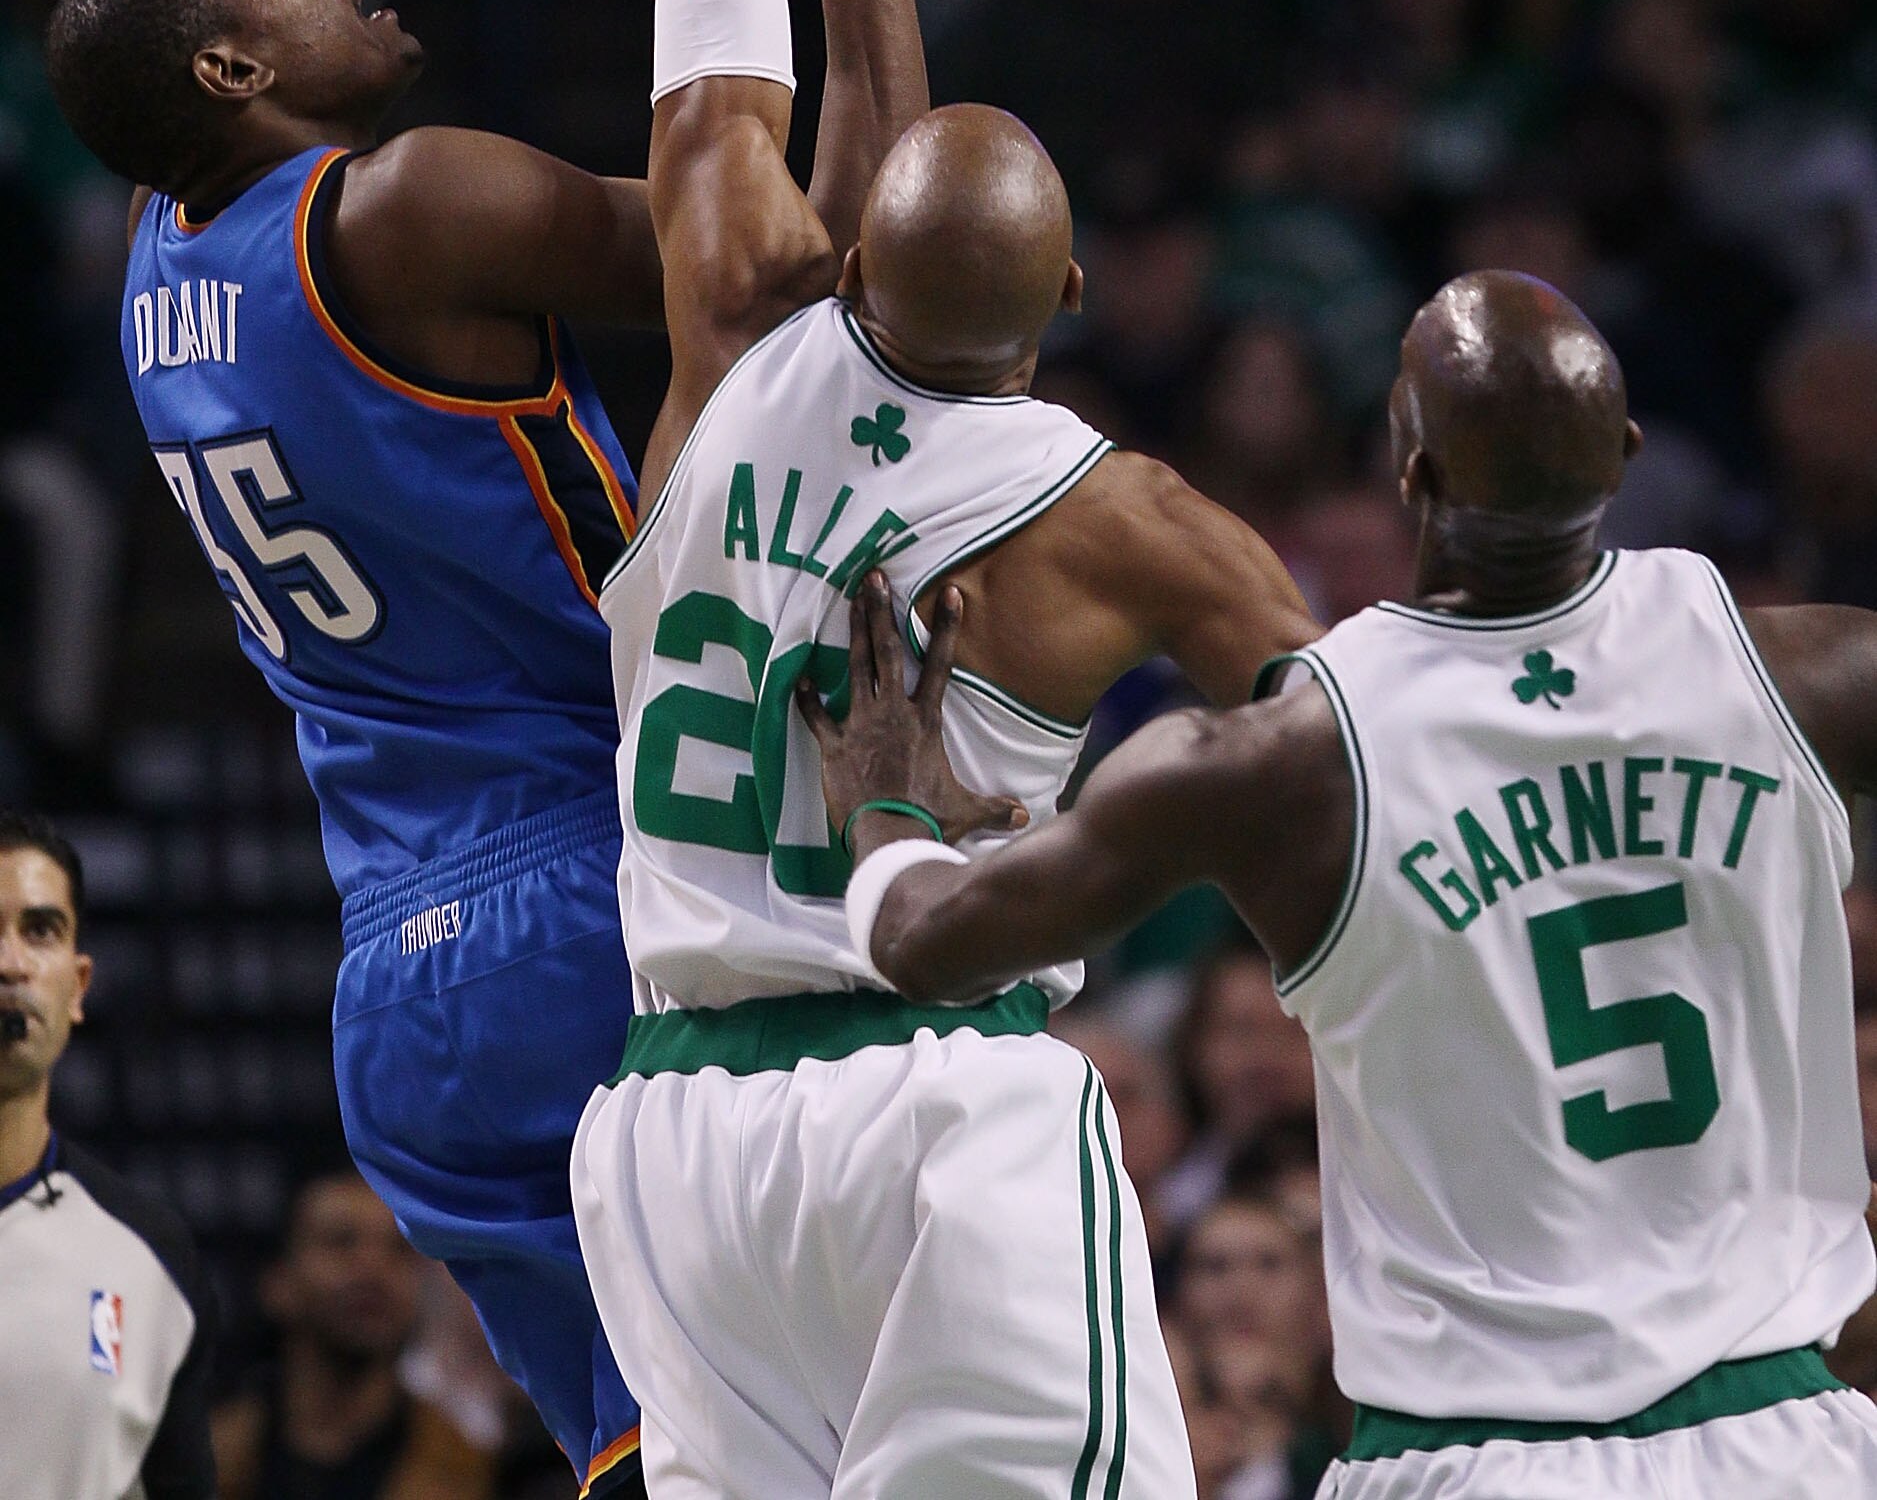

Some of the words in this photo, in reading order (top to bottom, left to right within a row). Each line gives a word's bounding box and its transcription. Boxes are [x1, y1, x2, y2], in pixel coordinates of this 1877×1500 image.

[401, 900, 461, 956] THUNDER
[1399, 757, 1781, 932] GARNETT
[1527, 881, 1721, 1162] 5
